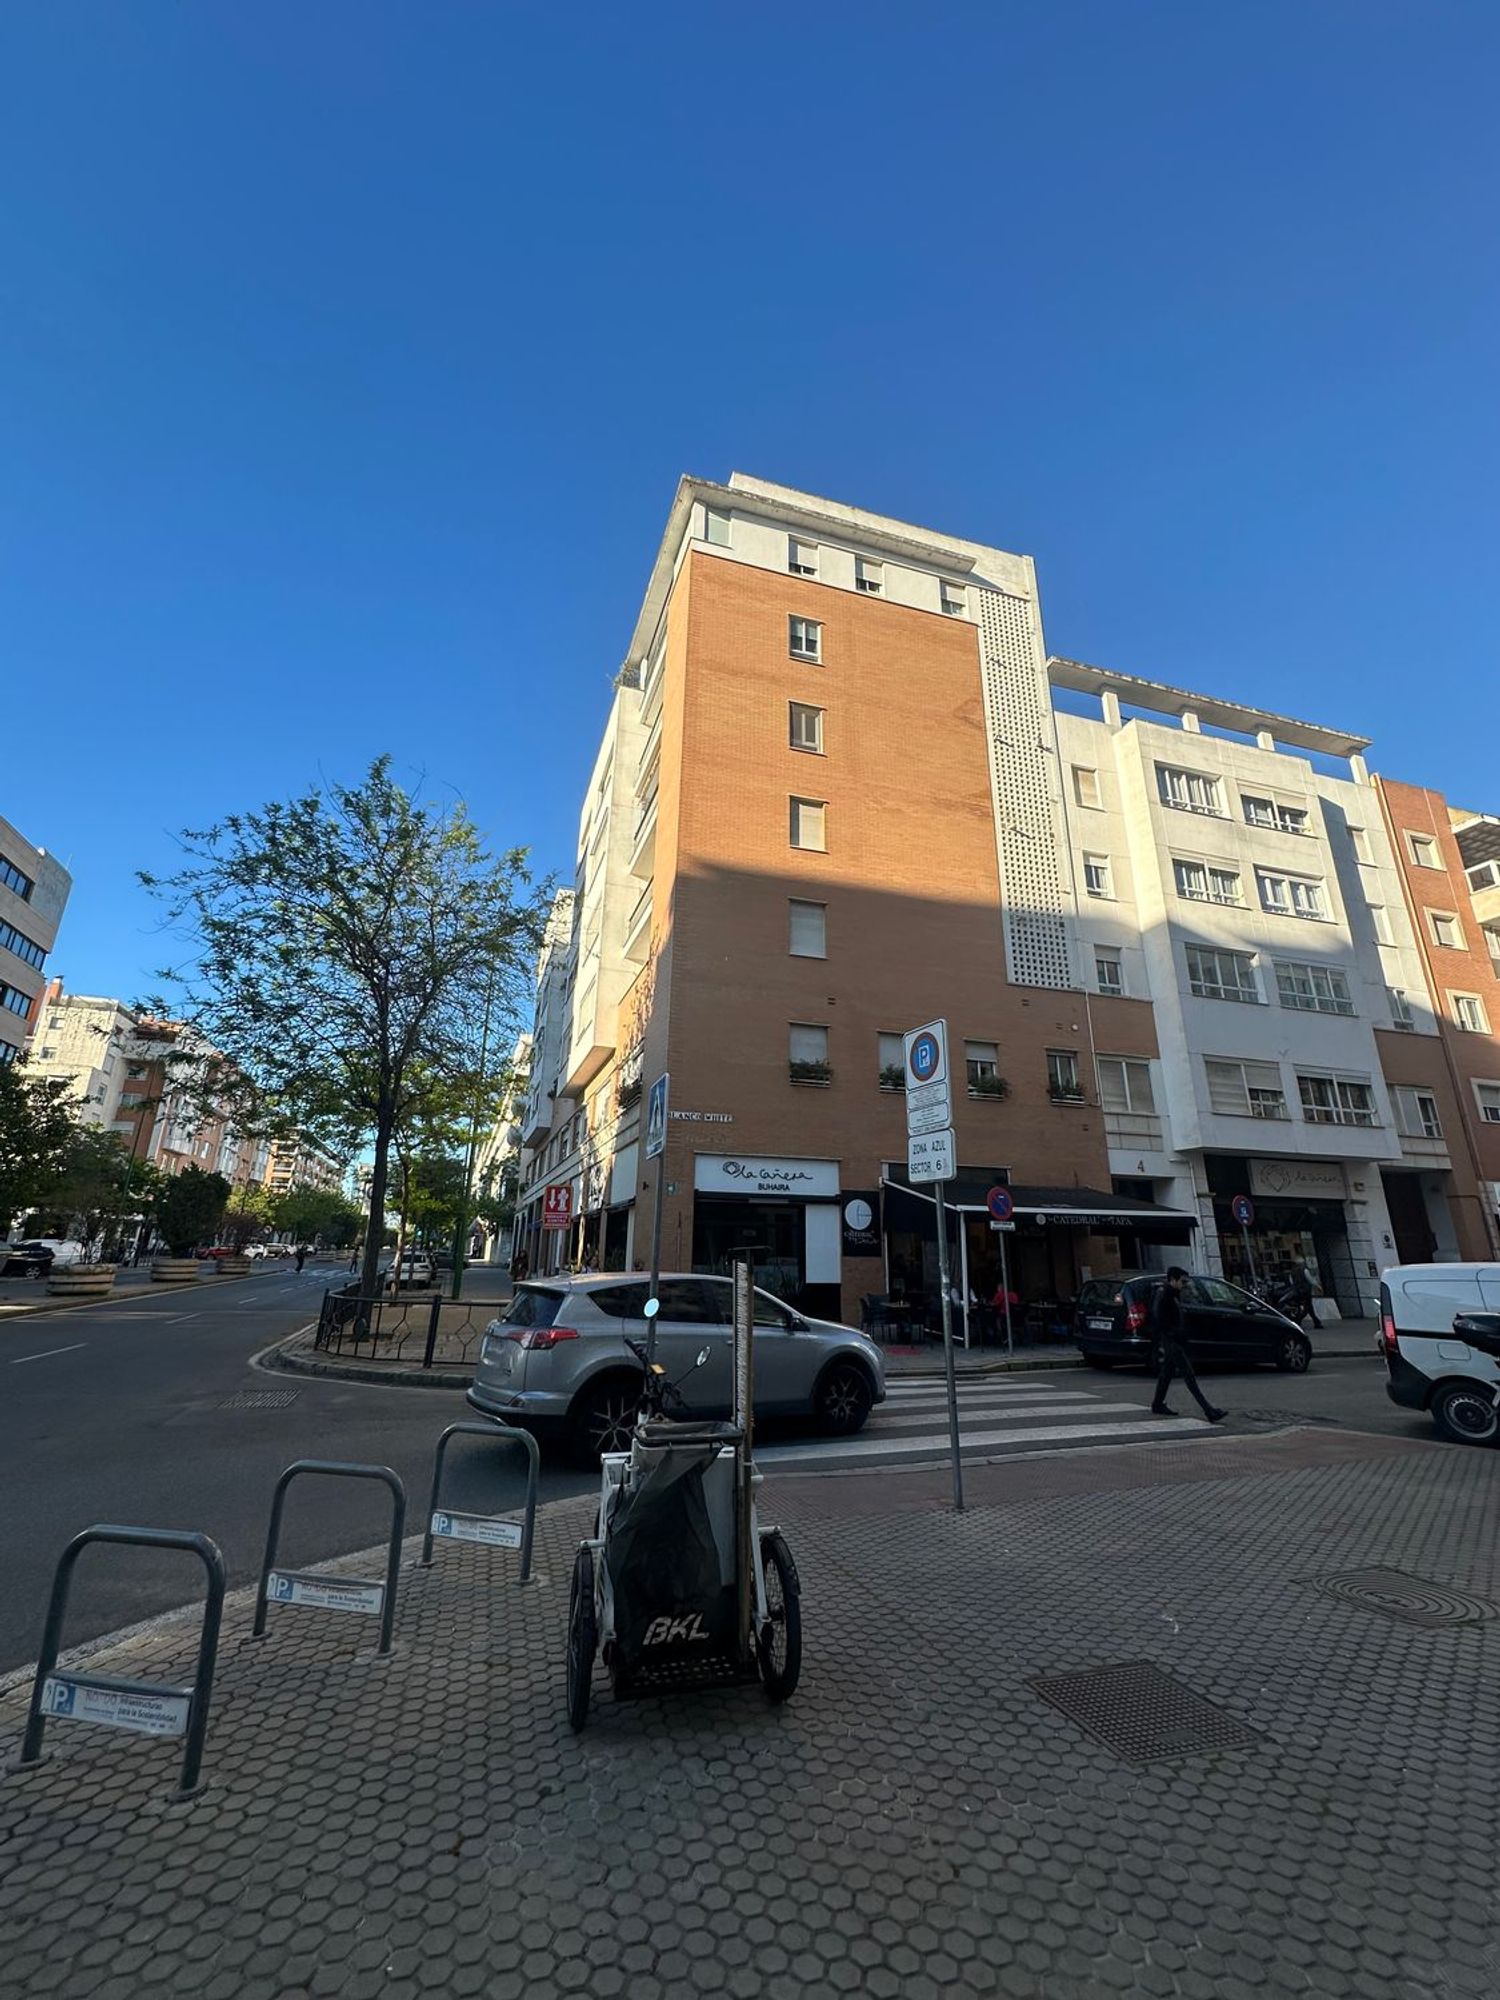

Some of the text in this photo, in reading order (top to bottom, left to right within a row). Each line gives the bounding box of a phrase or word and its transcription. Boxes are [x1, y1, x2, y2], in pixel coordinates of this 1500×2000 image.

[913, 1140, 946, 1155] ZONA AZUL
[910, 1160, 942, 1174] SECTOR 6
[758, 1183, 790, 1191] BUHAIRA
[276, 1578, 288, 1597] P
[643, 1612, 710, 1646] BKL
[53, 1685, 68, 1710] P
